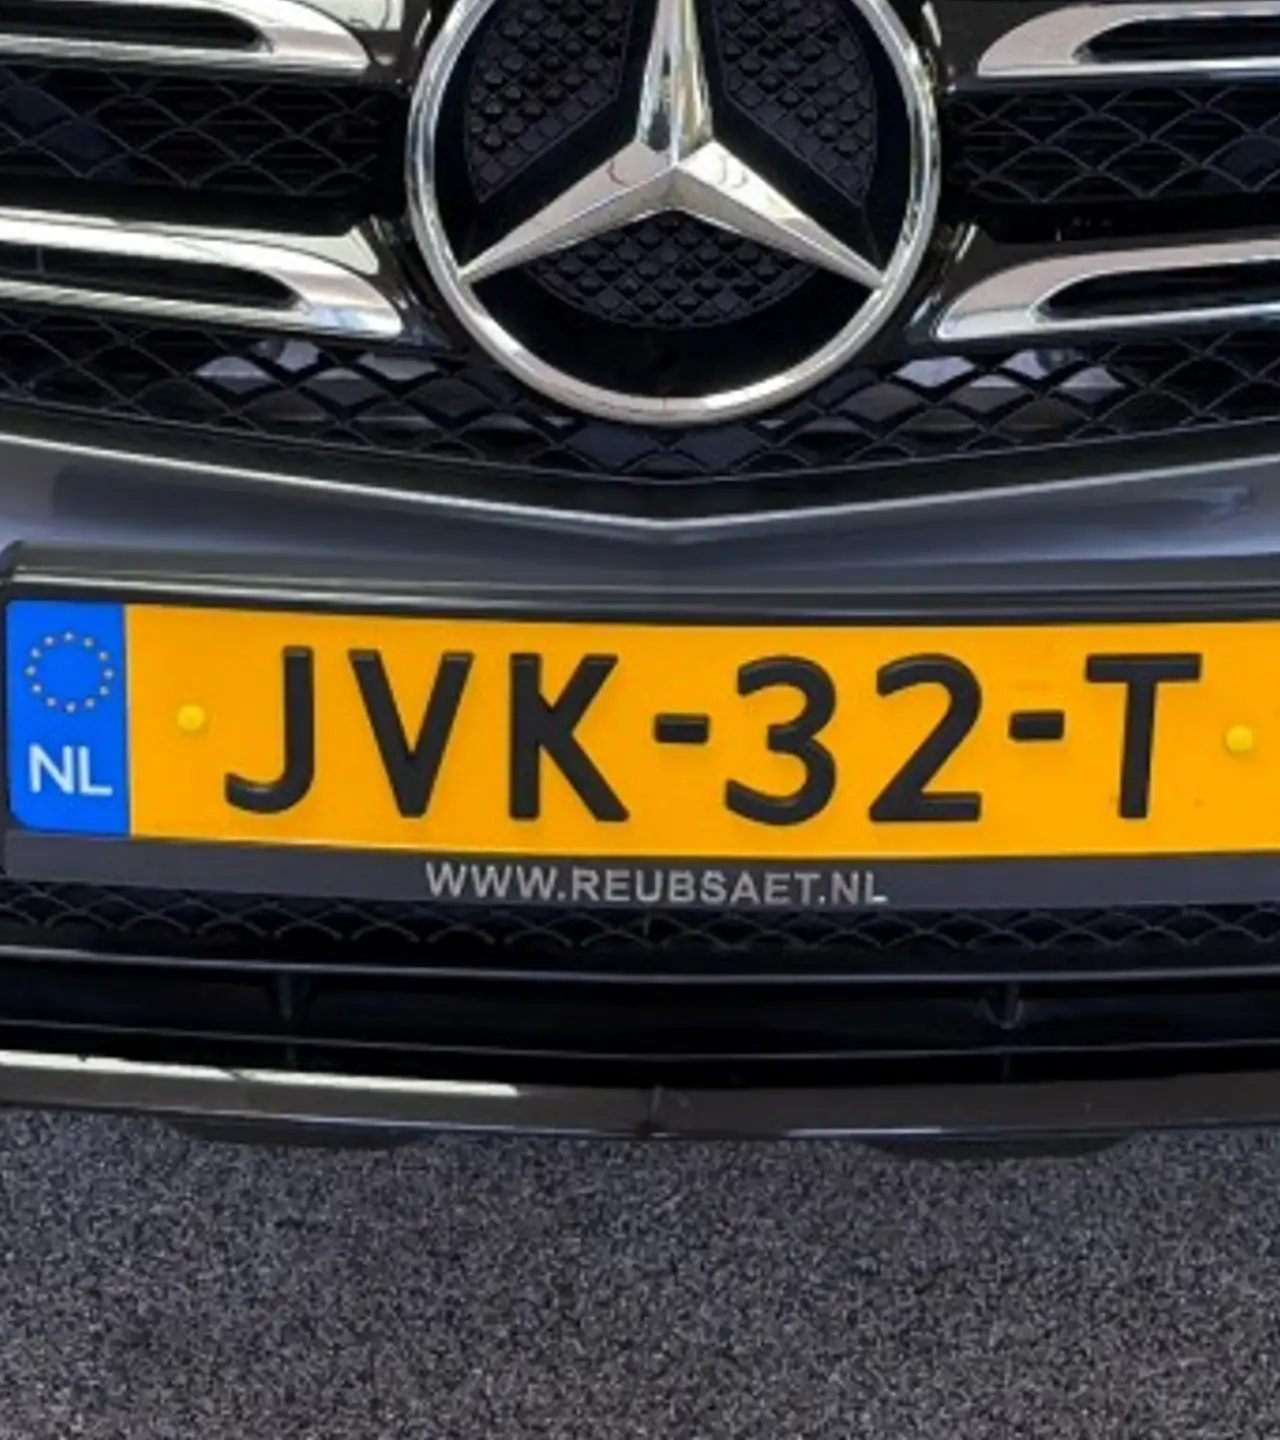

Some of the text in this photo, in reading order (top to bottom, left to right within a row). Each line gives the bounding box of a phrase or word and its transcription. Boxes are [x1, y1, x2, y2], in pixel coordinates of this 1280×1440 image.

[224, 646, 1203, 827] JVK-32-T
[29, 746, 113, 797] NL
[425, 862, 889, 905] WWW.REUBSAET.NL
